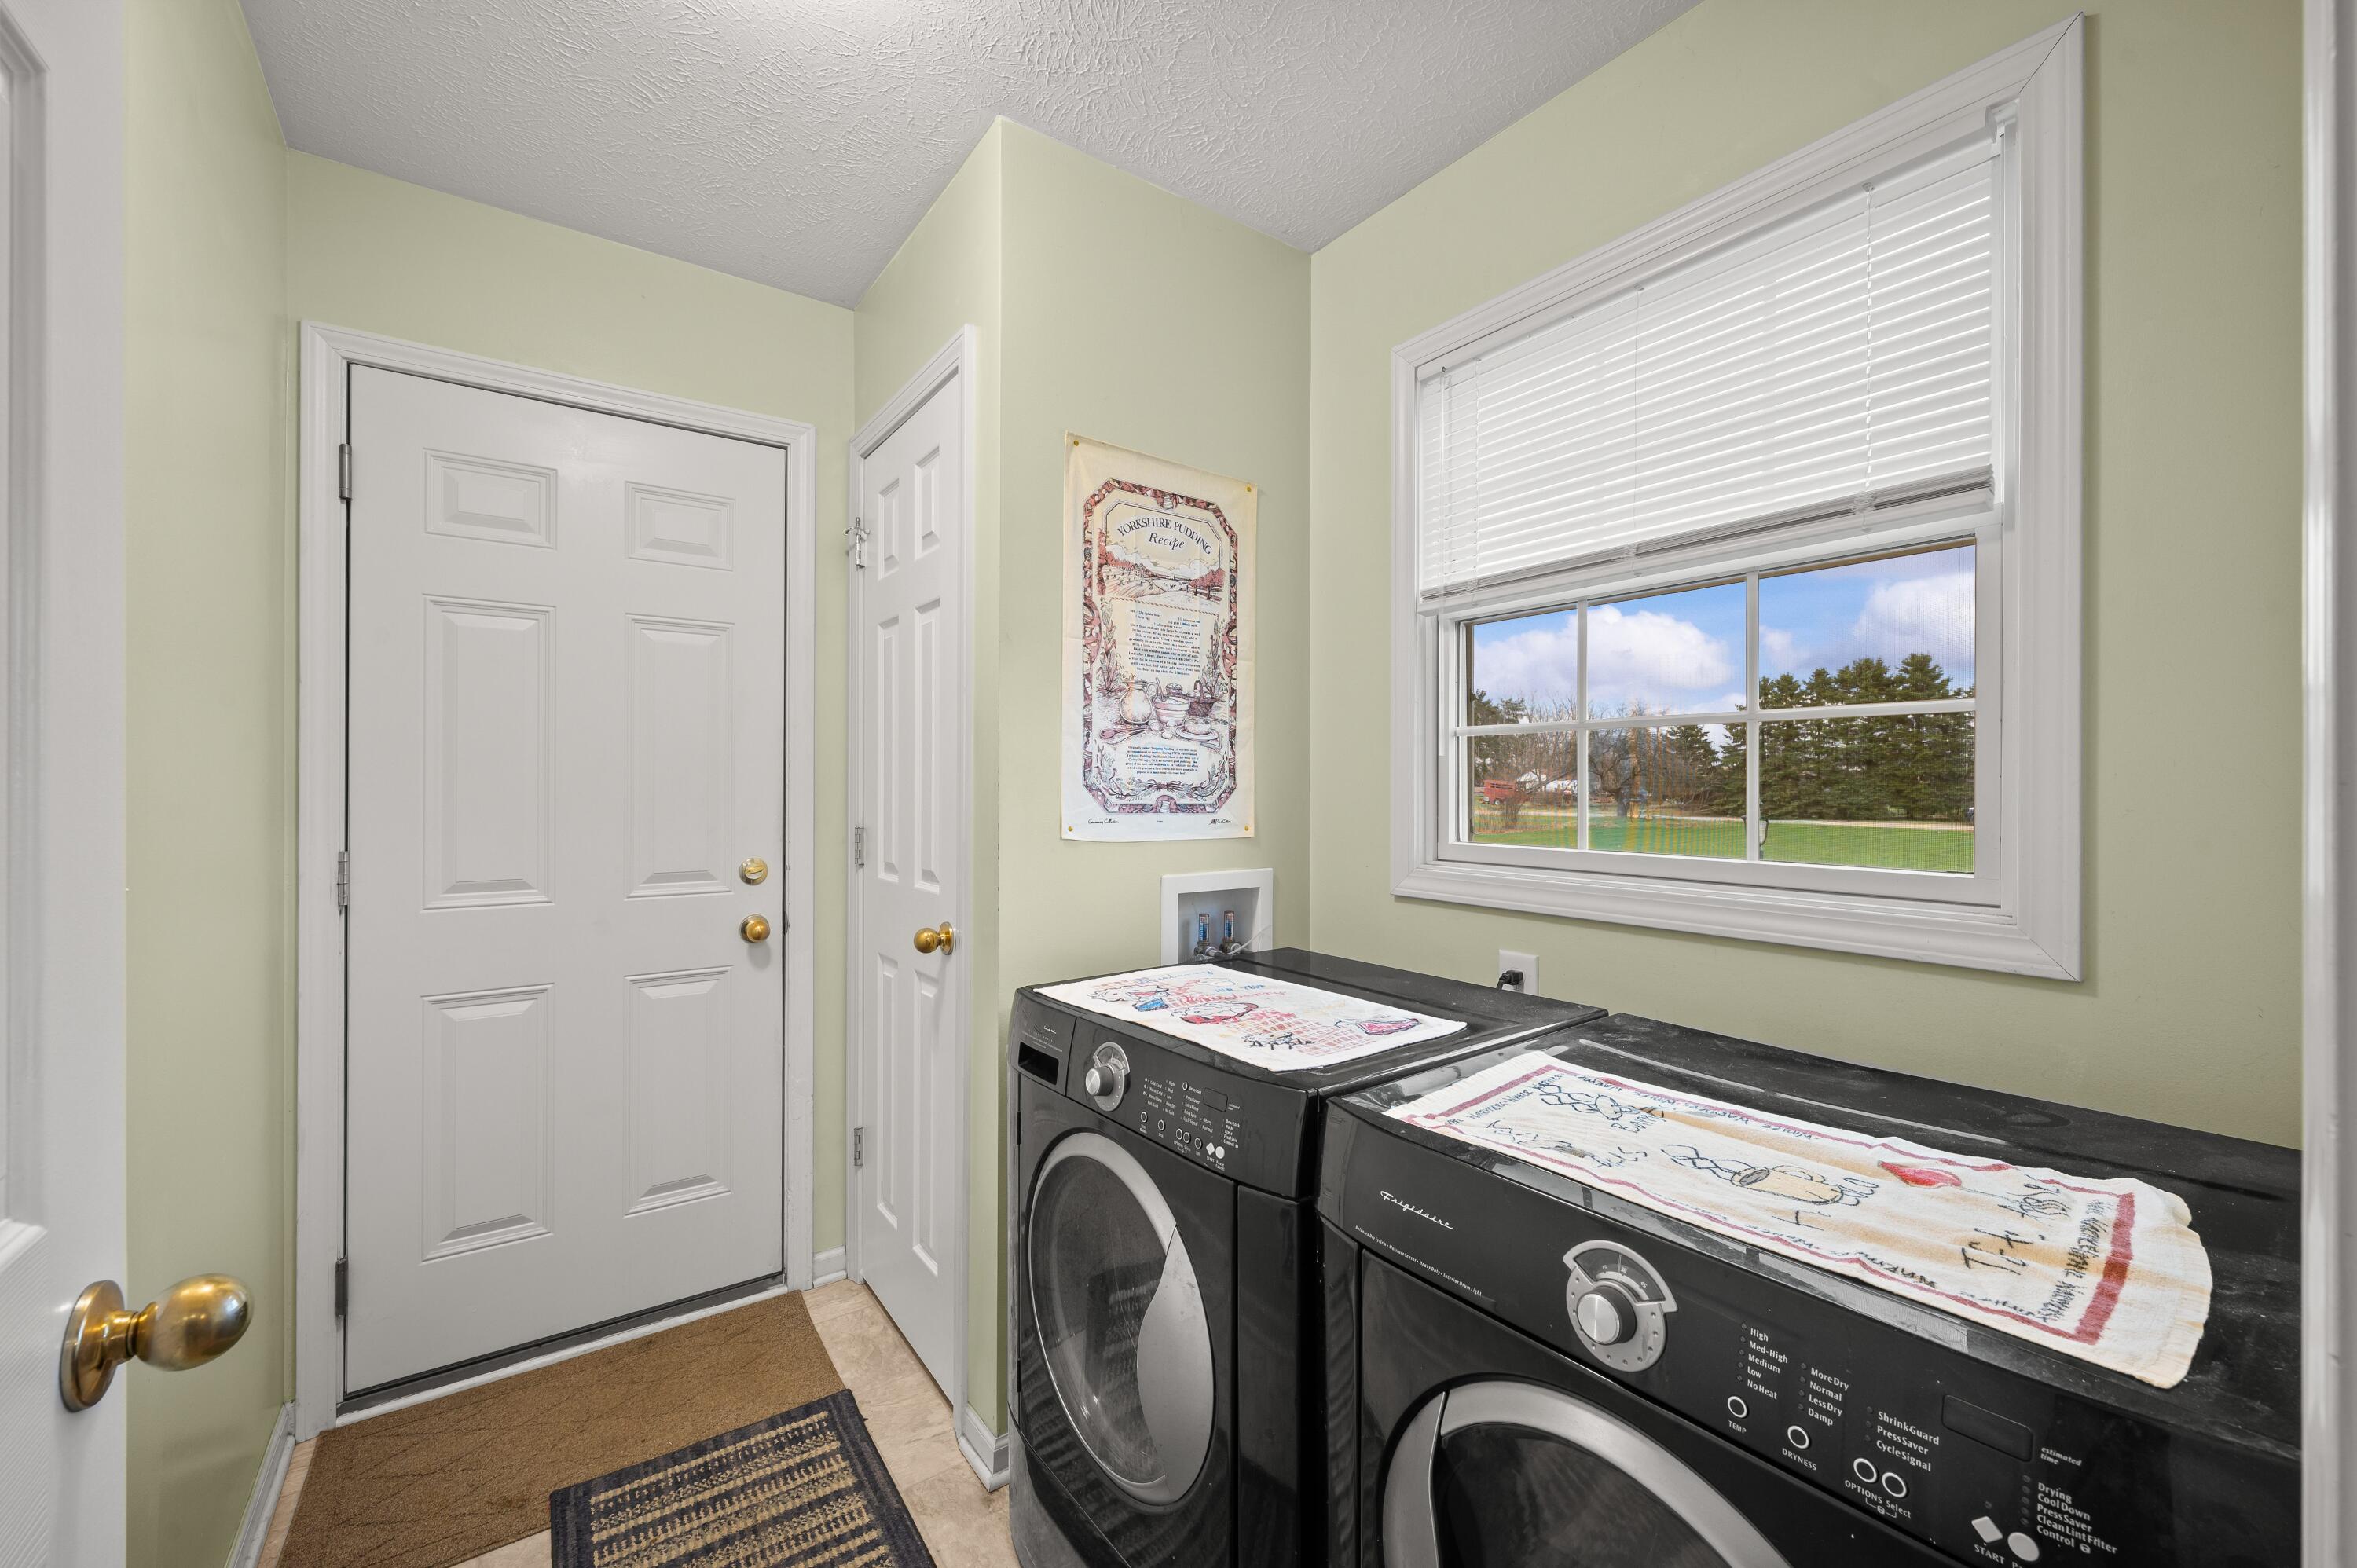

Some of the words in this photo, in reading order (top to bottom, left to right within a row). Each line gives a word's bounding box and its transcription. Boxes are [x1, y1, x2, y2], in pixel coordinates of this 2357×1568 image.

[1117, 518, 1171, 537] YORKSHIRE
[1174, 522, 1212, 555] PUDDING
[1149, 533, 1185, 550] Recipe
[1380, 1190, 1453, 1230] Frigidaire
[1405, 1253, 1417, 1262] Sensor
[1419, 1261, 1431, 1270] Heavy
[1431, 1266, 1440, 1276] Duty
[1443, 1273, 1459, 1284] Interior
[1459, 1281, 1471, 1291] Drum
[1471, 1286, 1483, 1297] Light
[1750, 1328, 1769, 1342] High
[1749, 1340, 1788, 1364] Med-High
[1747, 1366, 1762, 1379] Low
[1748, 1354, 1780, 1374] Medium
[1809, 1380, 1842, 1401] Normal
[1728, 1420, 1747, 1434] TEMP
[1808, 1408, 1834, 1427] Damp
[1782, 1448, 1816, 1471] DRYNESS
[2040, 1453, 2059, 1465] time
[2041, 1447, 2082, 1467] estimated
[1845, 1480, 1882, 1504] OPTIONS
[1886, 1500, 1912, 1519] Select
[2038, 1482, 2072, 1504] Drying
[2036, 1525, 2075, 1548] Control
[1974, 1544, 2005, 1564] START
